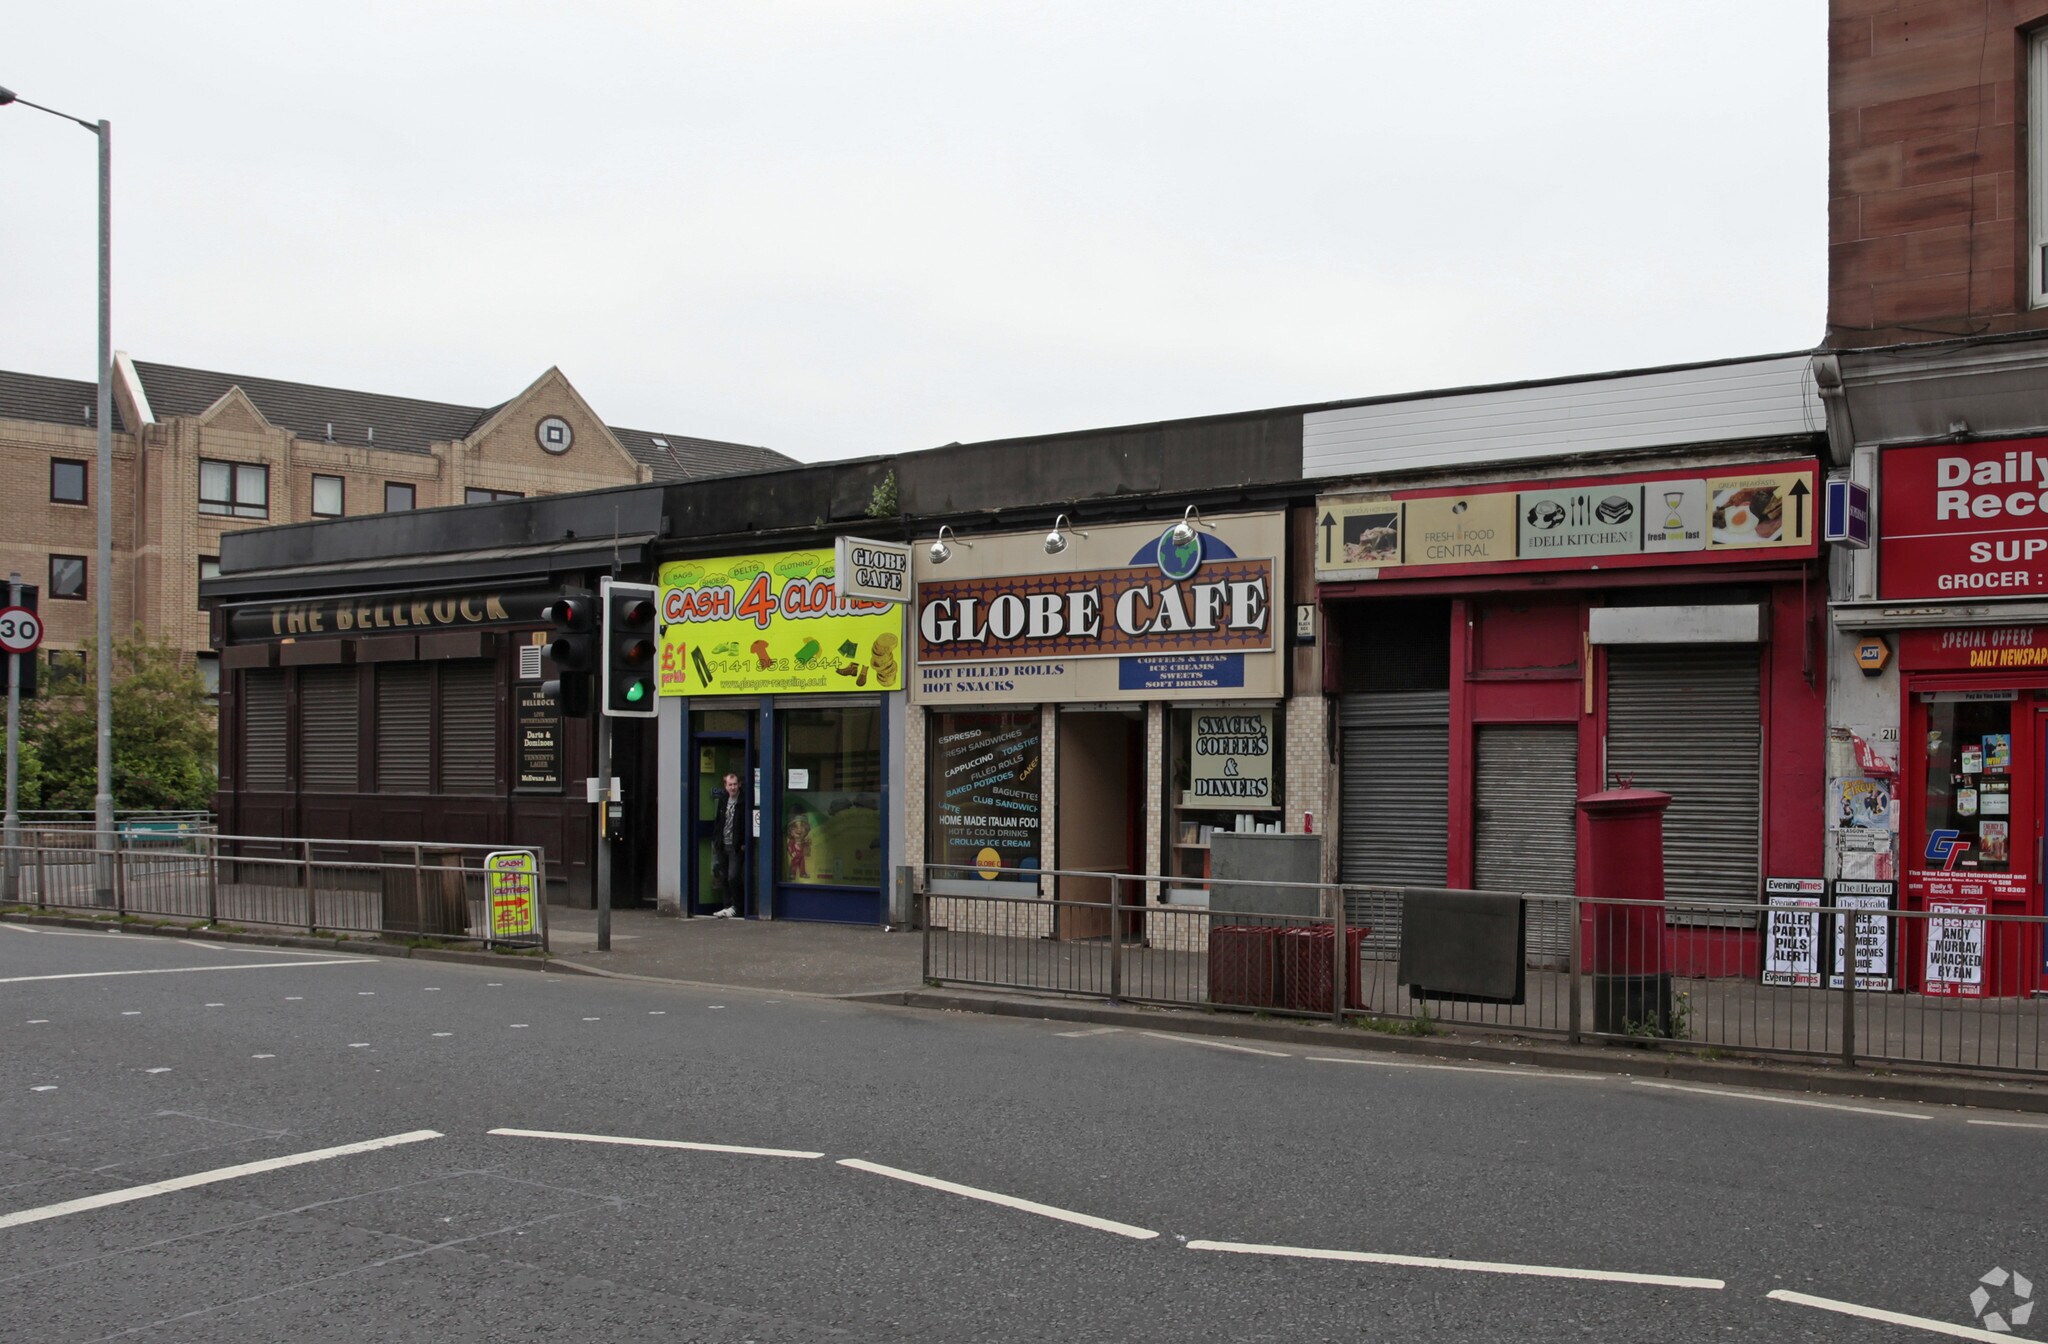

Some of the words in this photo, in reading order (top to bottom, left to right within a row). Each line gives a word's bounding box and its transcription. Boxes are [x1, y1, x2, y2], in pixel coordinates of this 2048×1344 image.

[1938, 451, 2048, 488] Daily
[1425, 532, 1454, 542] FRESH
[1464, 529, 1495, 541] FOOD
[1534, 535, 1563, 548] DELI
[1567, 531, 1628, 546] KITCHEN
[1648, 532, 1666, 541] fresh
[1686, 530, 1699, 540] fast
[1427, 543, 1489, 559] CENTRAL
[780, 559, 813, 572] CLOTHING
[852, 548, 906, 573] GLOBE
[673, 571, 693, 581] BAGS
[733, 563, 760, 577] BELTS
[856, 568, 902, 591] CAFE
[1938, 571, 2029, 590] GROCER
[664, 588, 732, 621] CASH
[737, 574, 778, 627] 4
[270, 603, 324, 637] THE
[336, 594, 509, 630] BELLROCK
[920, 587, 1100, 645] GLOBE
[1115, 577, 1269, 636] CAFE
[1, 619, 36, 640] 30
[1942, 630, 1986, 648] SPECIAL
[1992, 628, 2034, 647] OFFERS
[661, 641, 686, 671] £1
[1862, 648, 1879, 658] ADT
[1970, 649, 1998, 667] DAILY
[2000, 647, 2048, 666] NEWSPAP
[707, 659, 751, 674] 0141
[1137, 656, 1185, 664] COFFEES
[923, 668, 952, 679] HOT
[957, 666, 1009, 678] FILLED
[1014, 664, 1064, 676] ROLLS
[1149, 664, 1167, 672] ICE
[1170, 663, 1214, 671] CREAMS
[1160, 672, 1203, 680] SWEETS
[923, 682, 952, 693] HOT
[956, 680, 1014, 692] SNACKS
[1176, 679, 1218, 687] DRINKS
[522, 699, 555, 707] BELLROCK
[526, 731, 543, 739] Darts
[939, 728, 982, 745] ESPRESSO
[968, 729, 1022, 751] SANDWICHES
[524, 739, 554, 747] Dominoes
[1196, 736, 1269, 756] COFFEES
[944, 753, 994, 778] CAPPUCCINO
[971, 765, 997, 781] FILLED
[998, 754, 1024, 769] ROLLS
[1224, 758, 1239, 776] &
[945, 784, 972, 798] BAKED
[973, 771, 1014, 789] POTATOES
[1195, 777, 1269, 798] DINNERS
[972, 795, 994, 805] CLUB
[939, 815, 962, 826] HOME
[963, 816, 987, 826] MADE
[988, 816, 1017, 827] ITALIAN
[948, 828, 964, 836] HOT
[966, 828, 973, 836] &
[997, 829, 1029, 837] DRINKS
[949, 838, 985, 846] CROLLAS
[987, 838, 1000, 847] ICE
[1002, 839, 1031, 848] CREAM
[498, 860, 524, 868] CASH
[1861, 883, 1891, 894] Herald
[1961, 886, 1983, 894] mail
[1774, 913, 1811, 925] KILLER
[1838, 925, 1886, 935] SLAND'S
[1944, 928, 1970, 940] ANDY
[1776, 938, 1807, 950] PILLS
[1773, 950, 1809, 962] ALERT
[1930, 952, 1980, 966] WHACKED
[1855, 959, 1872, 968] UIDE
